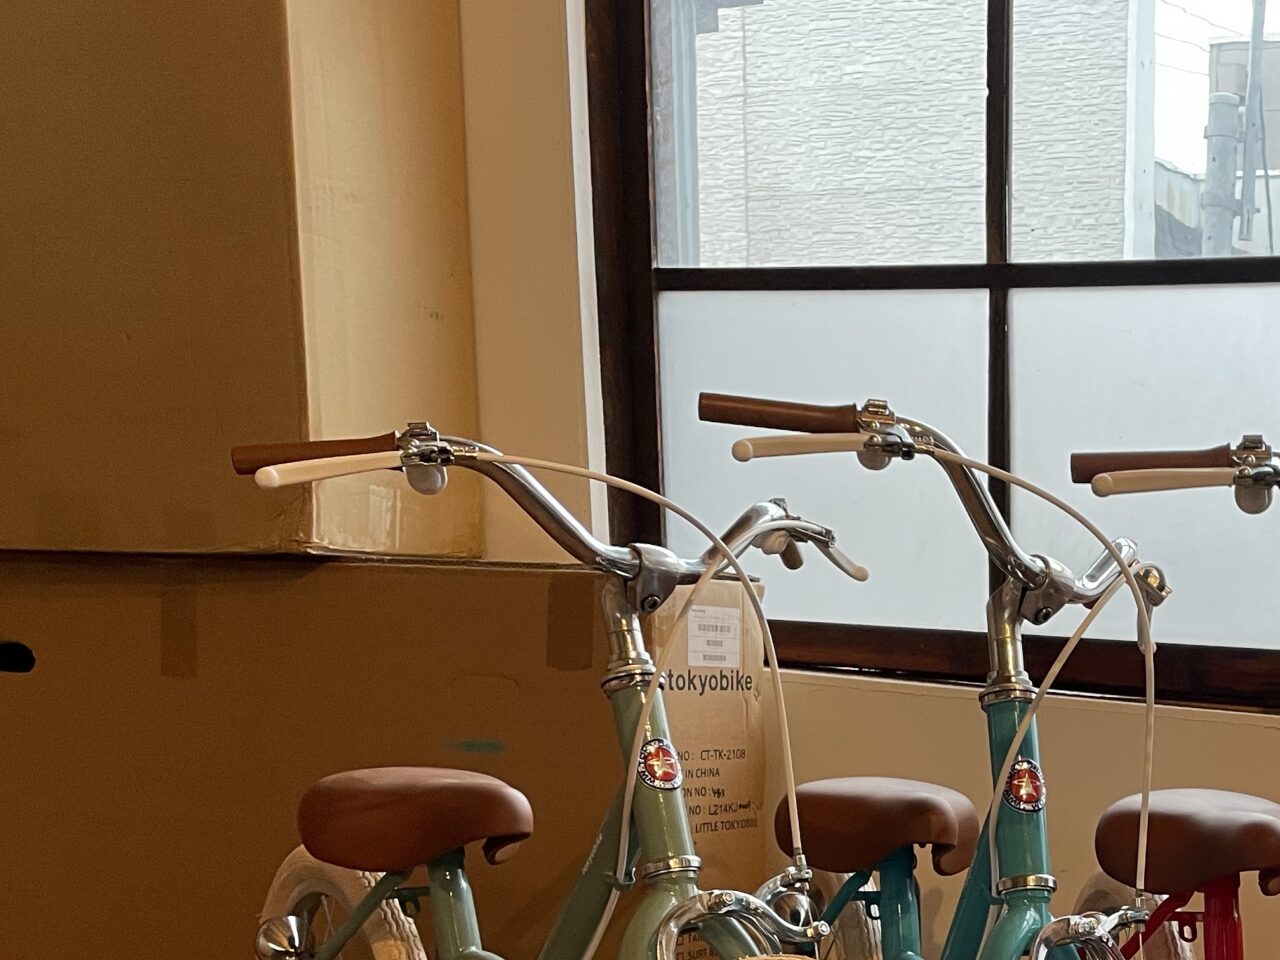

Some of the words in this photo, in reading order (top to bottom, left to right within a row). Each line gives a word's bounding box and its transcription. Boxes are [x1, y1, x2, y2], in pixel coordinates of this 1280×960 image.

[667, 668, 753, 697] tokyobike
[685, 769, 694, 779] IN
[695, 767, 720, 779] CHINA
[695, 820, 718, 834] LITTLE
